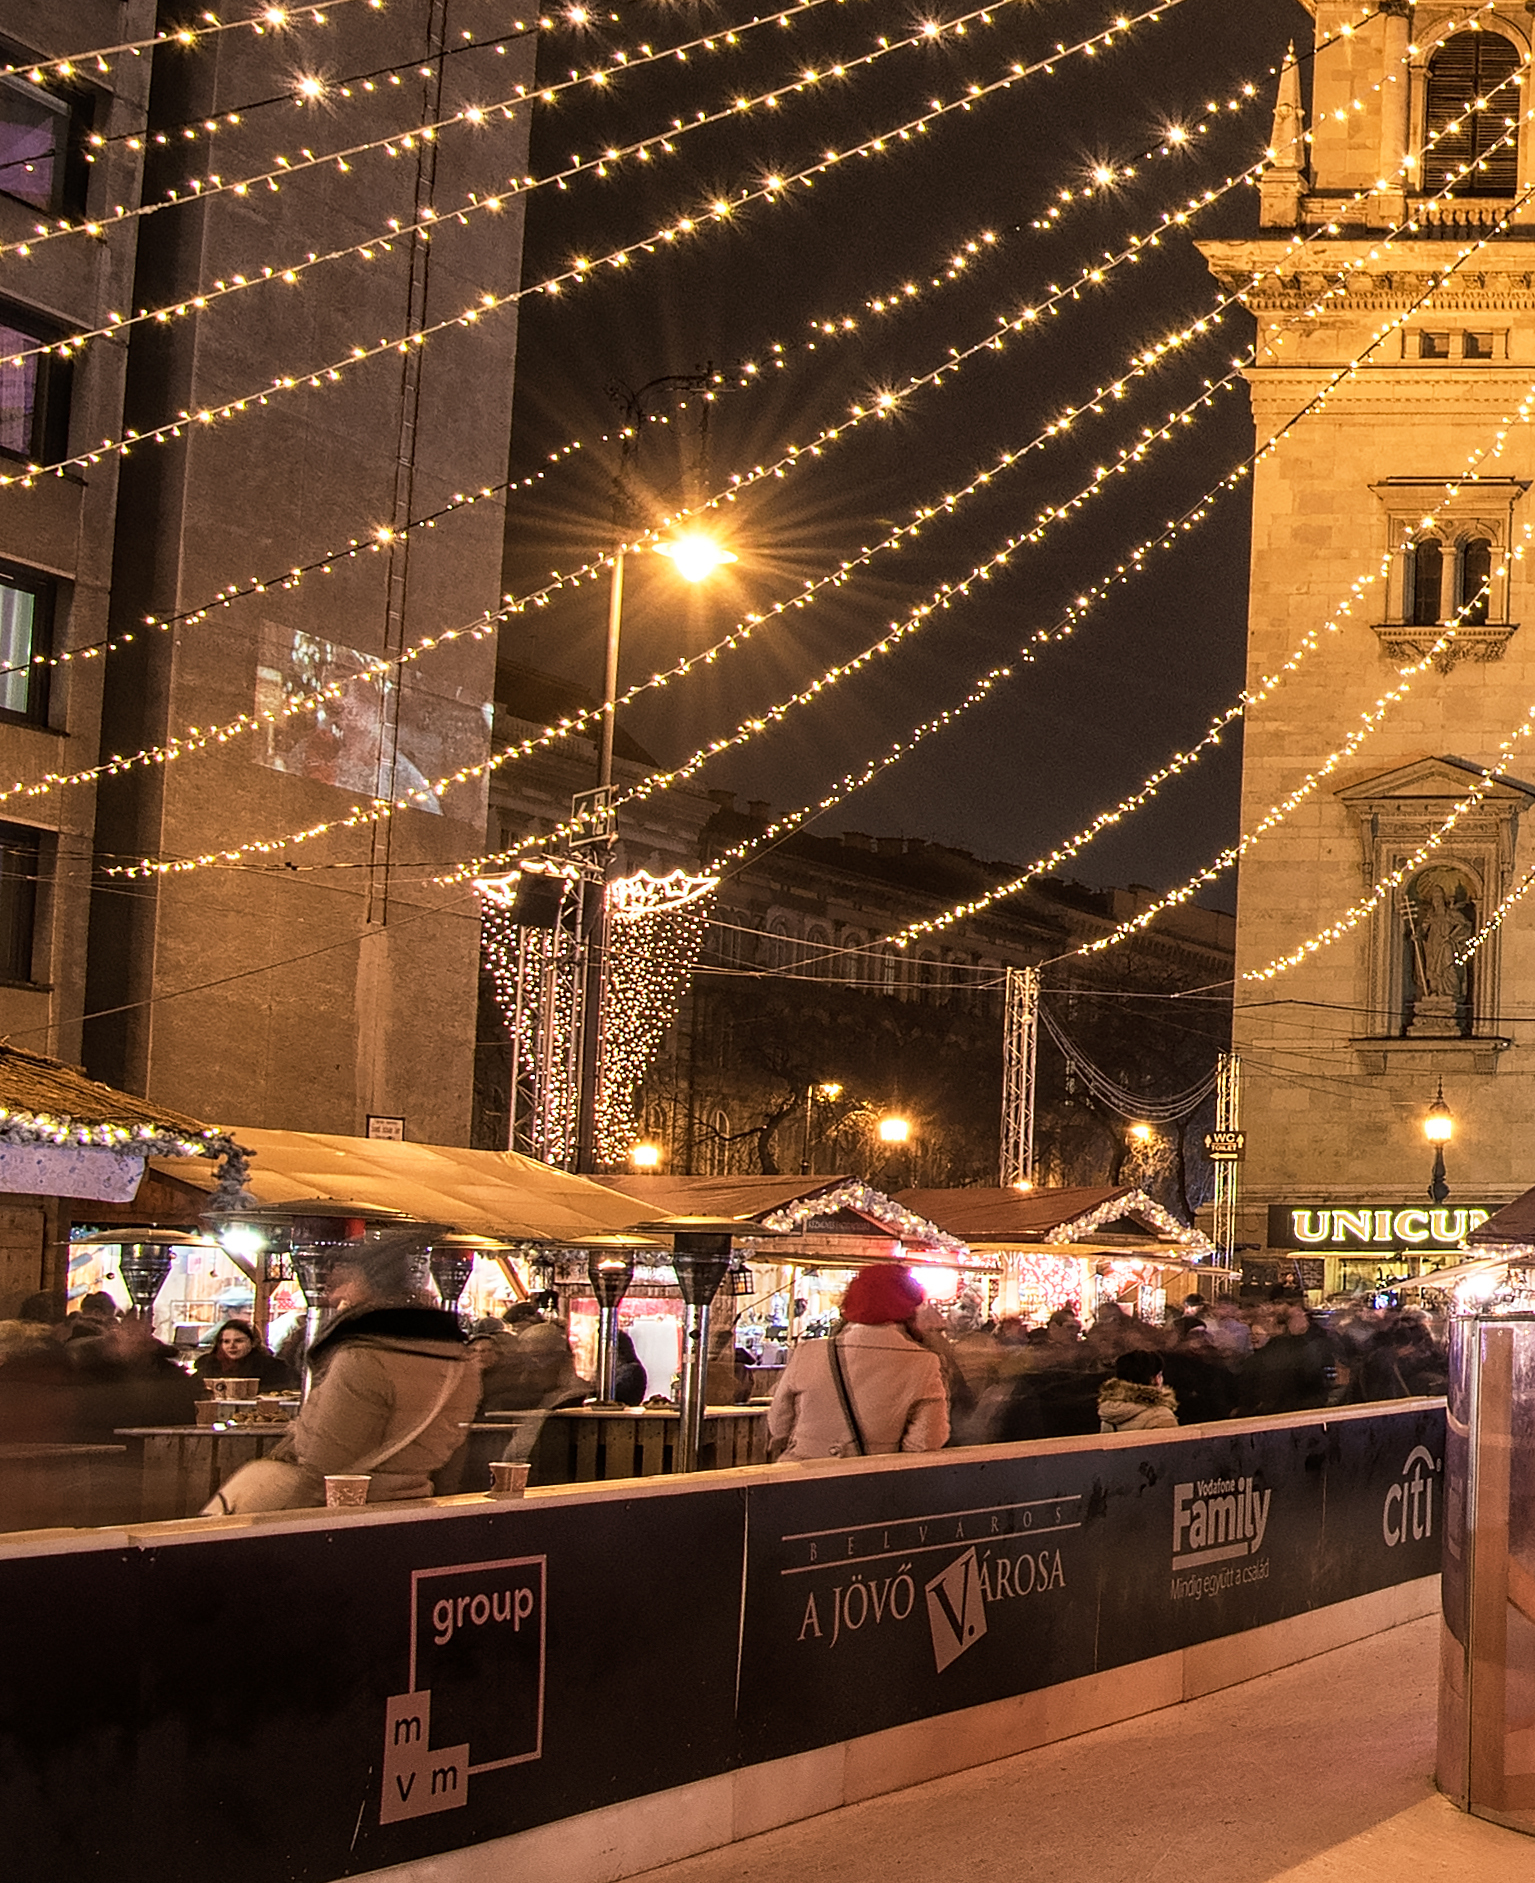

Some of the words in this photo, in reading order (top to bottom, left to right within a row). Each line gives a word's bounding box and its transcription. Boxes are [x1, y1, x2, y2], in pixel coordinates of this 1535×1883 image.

[1213, 1133, 1236, 1143] WC
[1173, 1476, 1272, 1554] Family
[1197, 1478, 1236, 1497] Vodafone
[1383, 1445, 1435, 1547] citi
[810, 1506, 1062, 1562] BELVÁROS
[797, 1591, 823, 1642] A
[829, 1562, 916, 1649] JÖVŐ
[1170, 1574, 1202, 1600] Mindig
[1203, 1567, 1234, 1597] együtt
[1235, 1569, 1241, 1585] a
[1242, 1557, 1270, 1583] család
[433, 1587, 534, 1646] group
